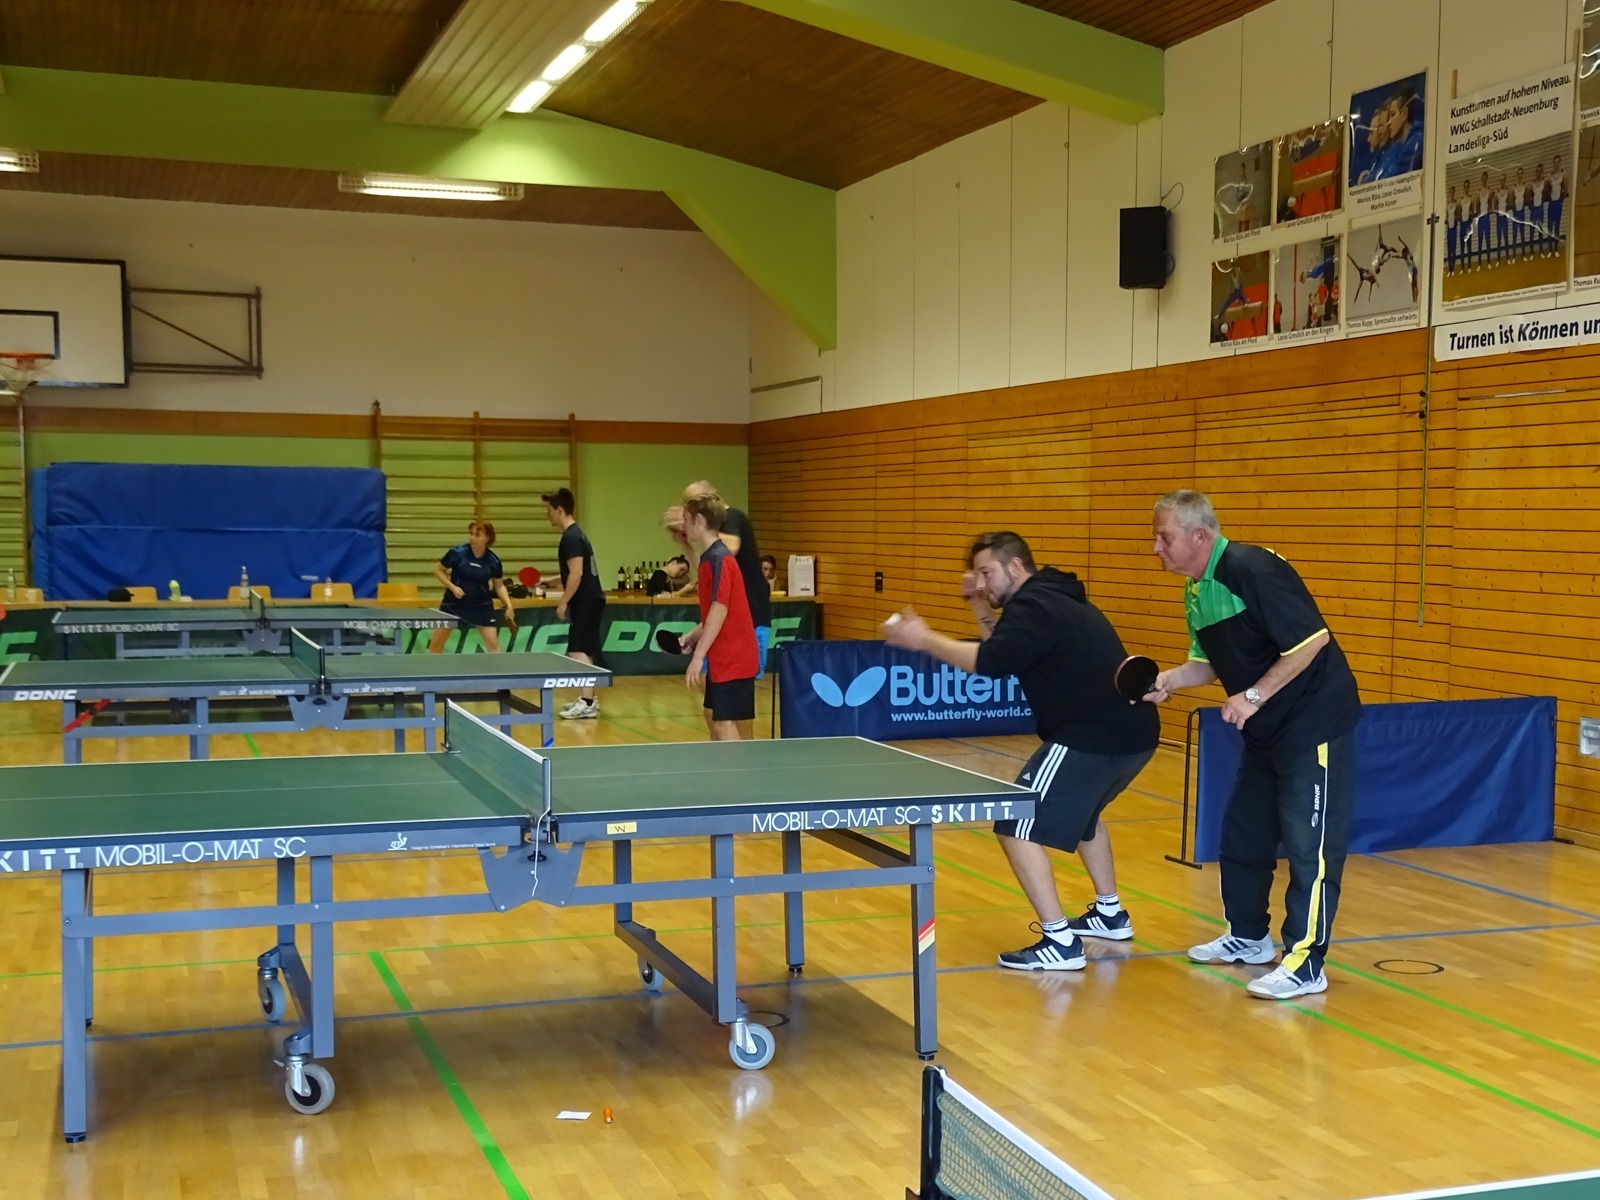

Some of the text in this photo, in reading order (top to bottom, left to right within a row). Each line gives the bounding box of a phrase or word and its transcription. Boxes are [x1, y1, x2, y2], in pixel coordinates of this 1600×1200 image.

[1451, 75, 1571, 118] Kunstturnen auf hohem Niveau.
[1450, 97, 1559, 136] WKG Schallstadt-Neuenburg
[1448, 127, 1508, 154] Landesliga-Süd
[1449, 332, 1495, 350] Turnen
[1500, 324, 1514, 344] ist
[1518, 320, 1579, 342] Können
[64, 624, 102, 634] SKITT
[166, 623, 180, 631] SC
[400, 620, 411, 629] SC
[415, 620, 449, 629] SKITT
[14, 690, 77, 700] DONIC
[544, 677, 597, 688] DONIC
[752, 807, 887, 833] MOBIL-O-MAT
[894, 805, 921, 825] SC
[96, 839, 263, 868] MOBIL-O-MAT
[274, 837, 306, 859] SC
